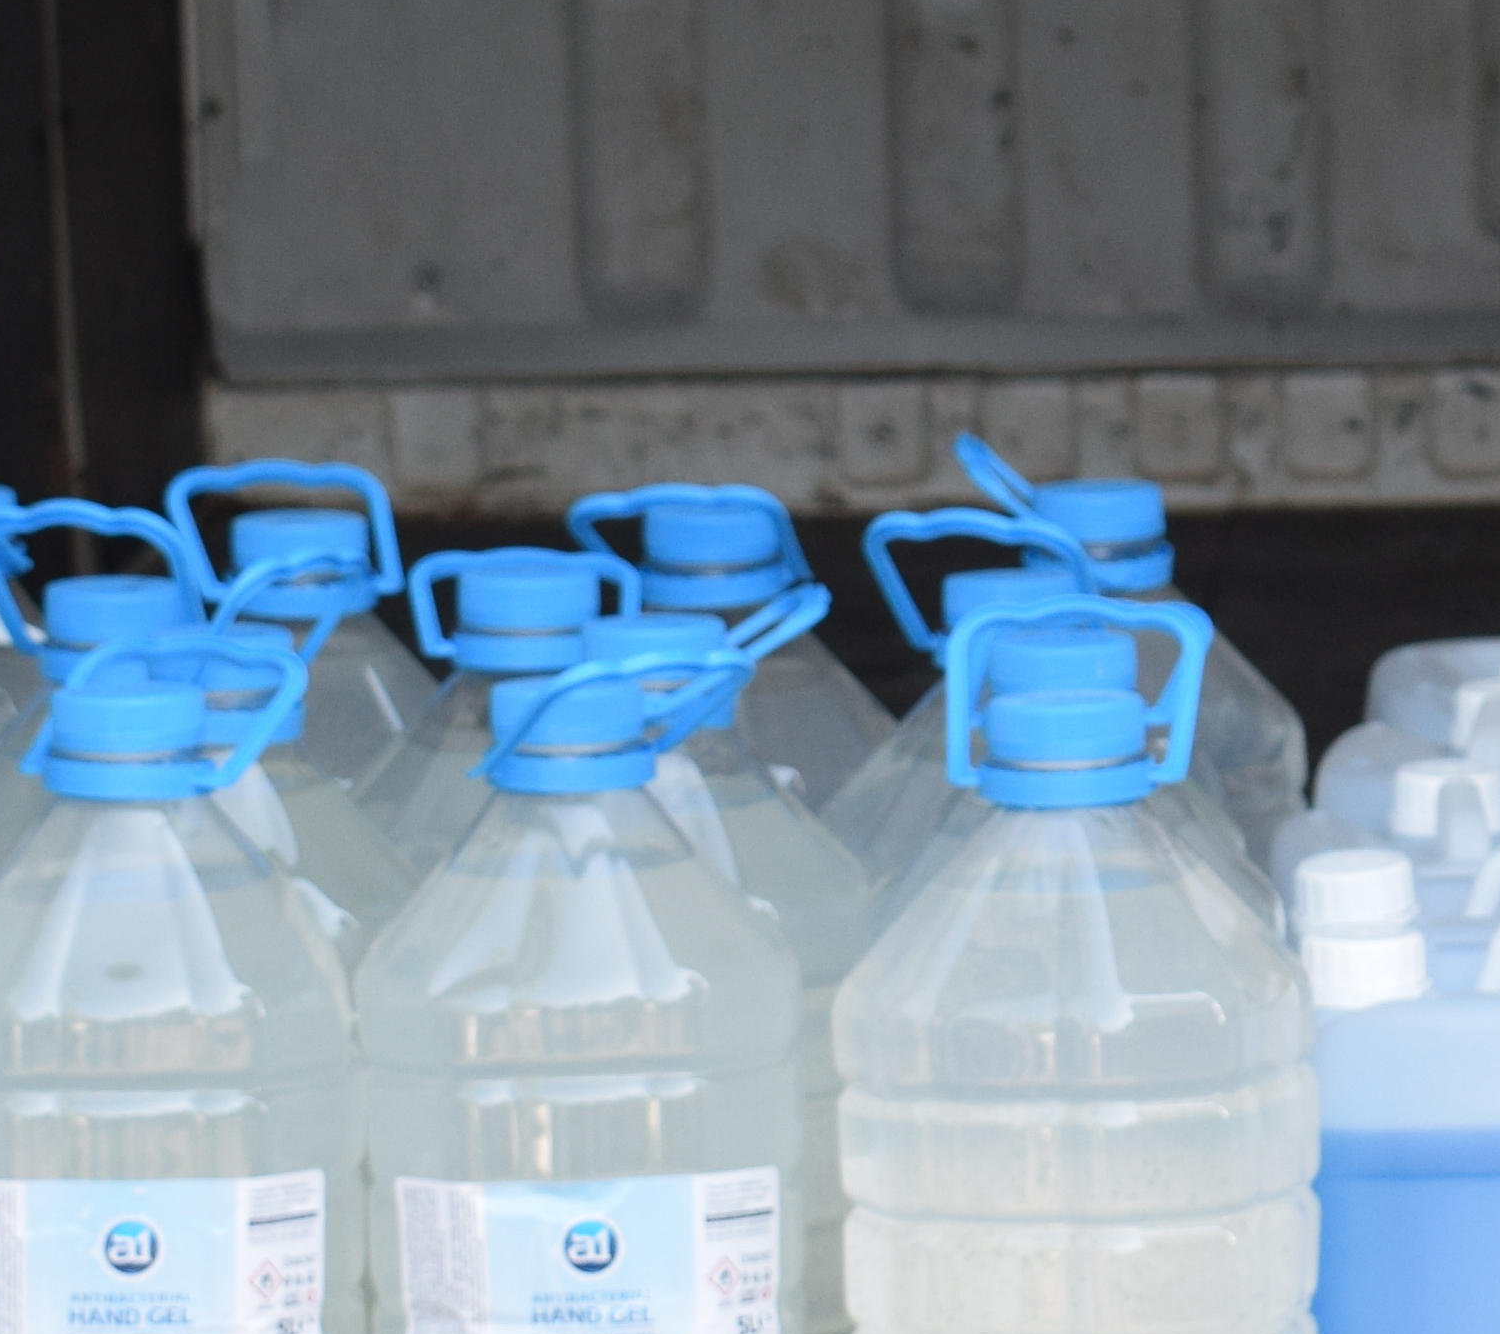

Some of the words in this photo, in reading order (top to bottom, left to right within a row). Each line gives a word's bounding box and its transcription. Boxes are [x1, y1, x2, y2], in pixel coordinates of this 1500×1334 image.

[68, 1306, 141, 1325] HAND
[147, 1305, 192, 1324] GEL
[532, 1305, 601, 1324] HAND
[608, 1304, 653, 1324] GEL
